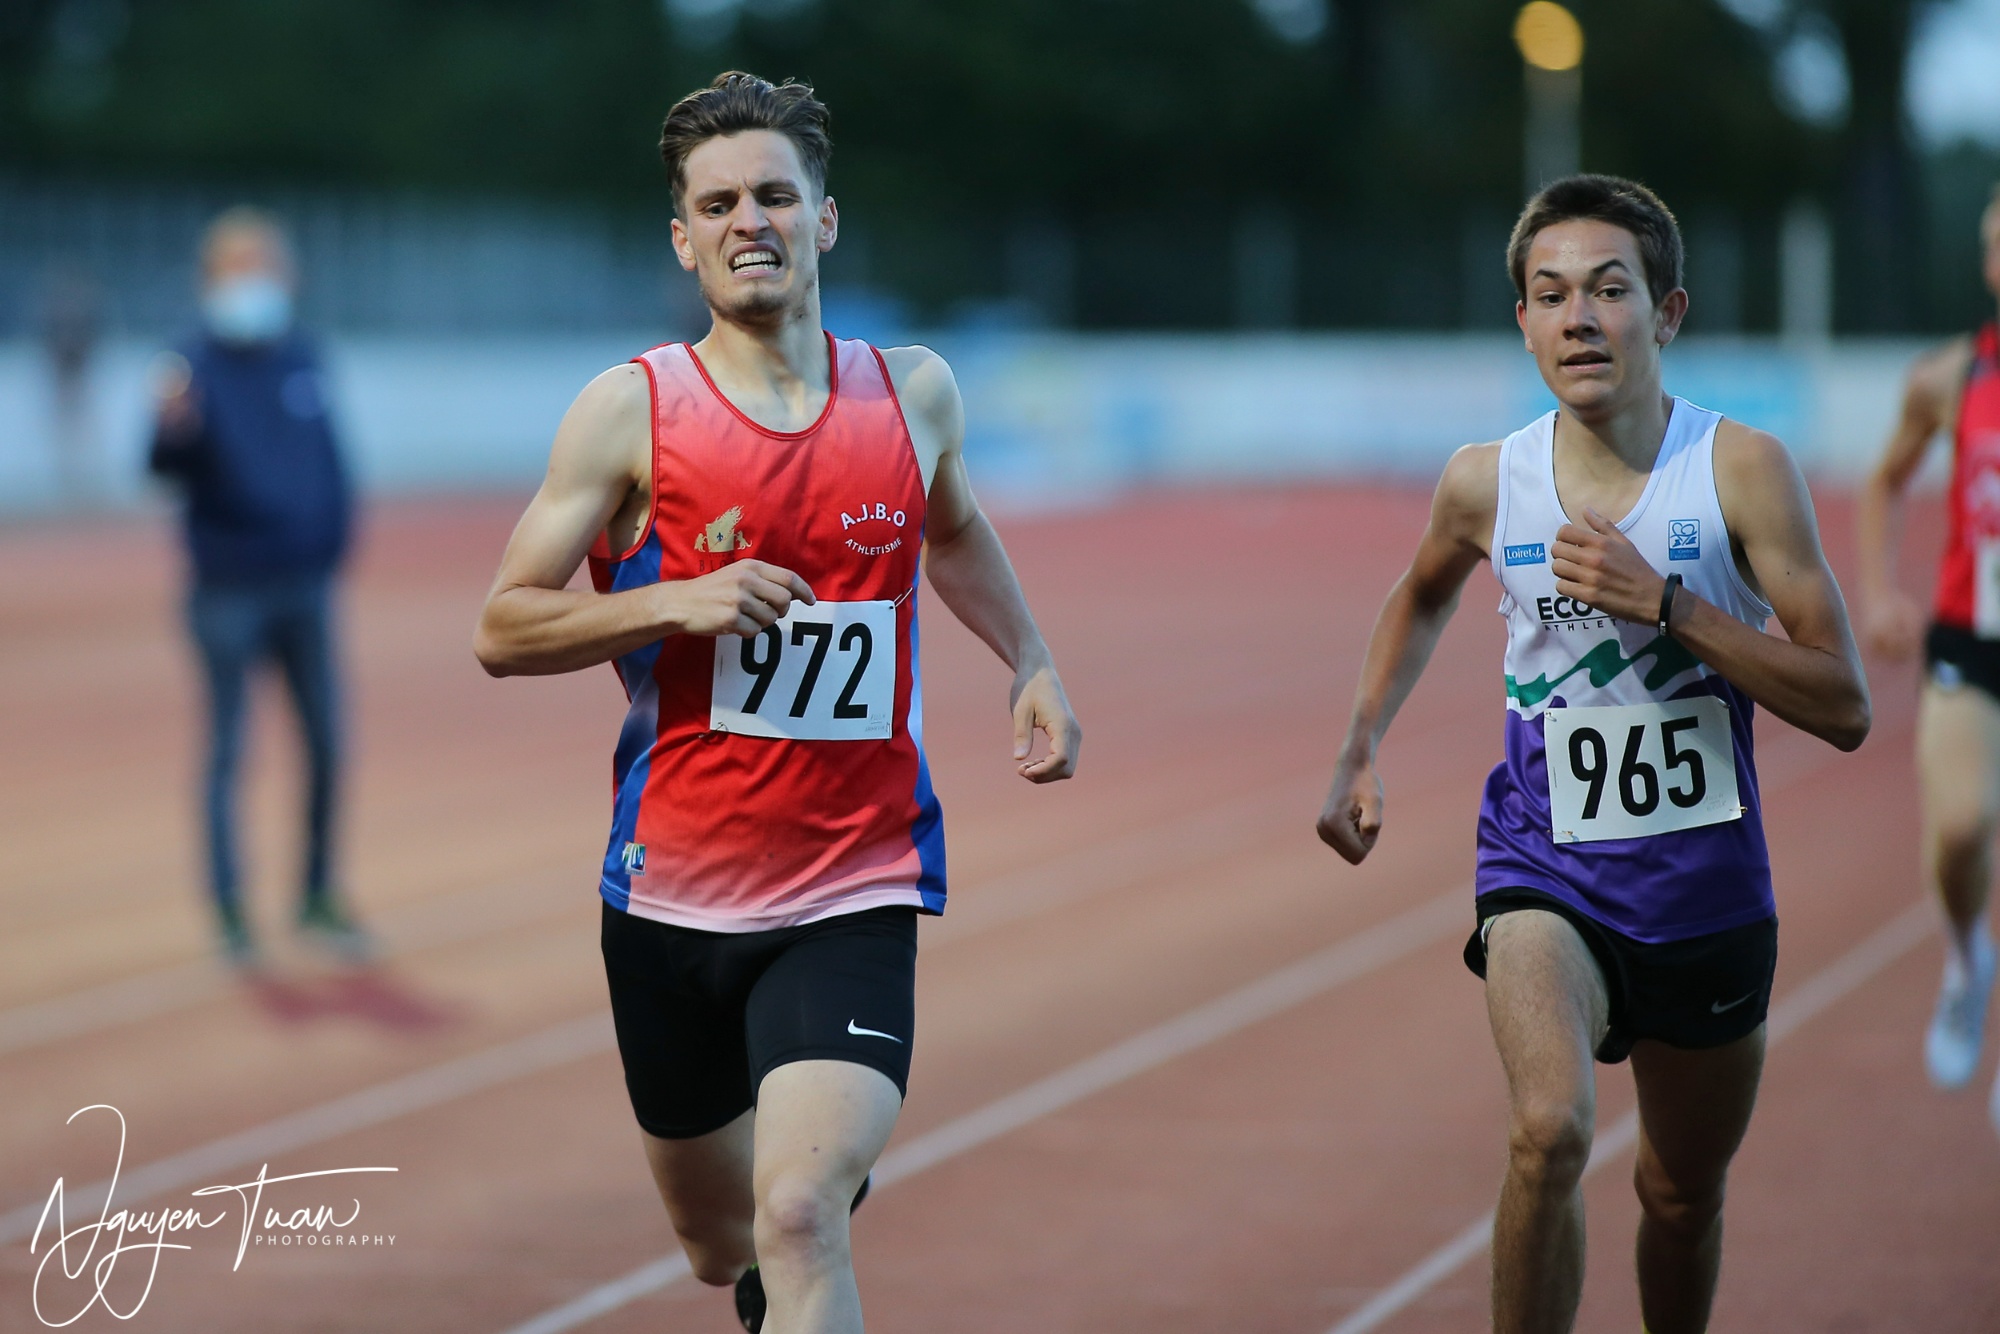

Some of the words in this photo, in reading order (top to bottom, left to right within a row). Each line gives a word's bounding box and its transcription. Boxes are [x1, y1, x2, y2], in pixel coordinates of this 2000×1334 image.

[840, 502, 906, 531] A.J.B.O
[845, 536, 903, 556] ATHLETISME
[1506, 547, 1533, 560] Loiret
[740, 621, 873, 719] 972
[1567, 715, 1707, 820] 965
